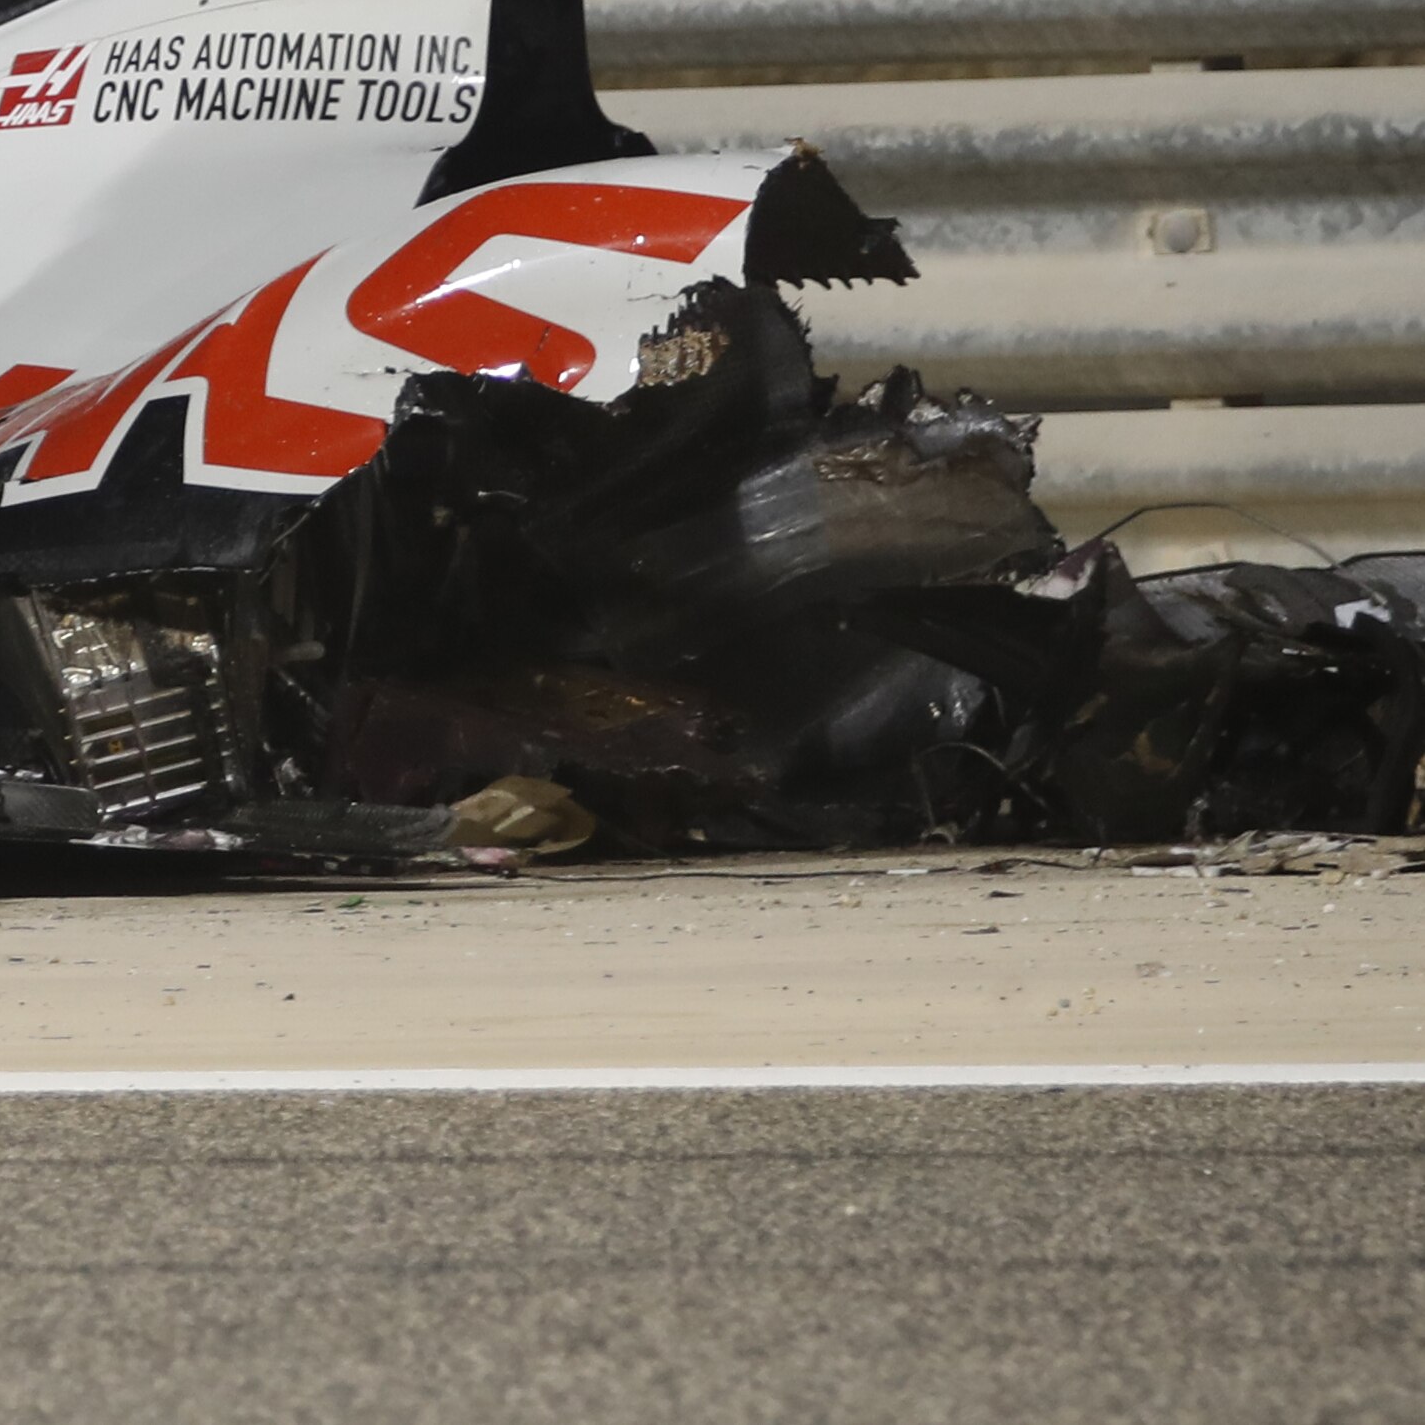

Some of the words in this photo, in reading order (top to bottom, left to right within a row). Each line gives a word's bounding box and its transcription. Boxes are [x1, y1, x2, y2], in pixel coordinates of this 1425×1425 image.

[104, 35, 185, 75] HAAS
[192, 32, 402, 72] AUTOMATION
[413, 34, 480, 76] INC.
[93, 78, 164, 123] CNC
[173, 77, 345, 122] MACHINE
[357, 79, 477, 124] TOOLS
